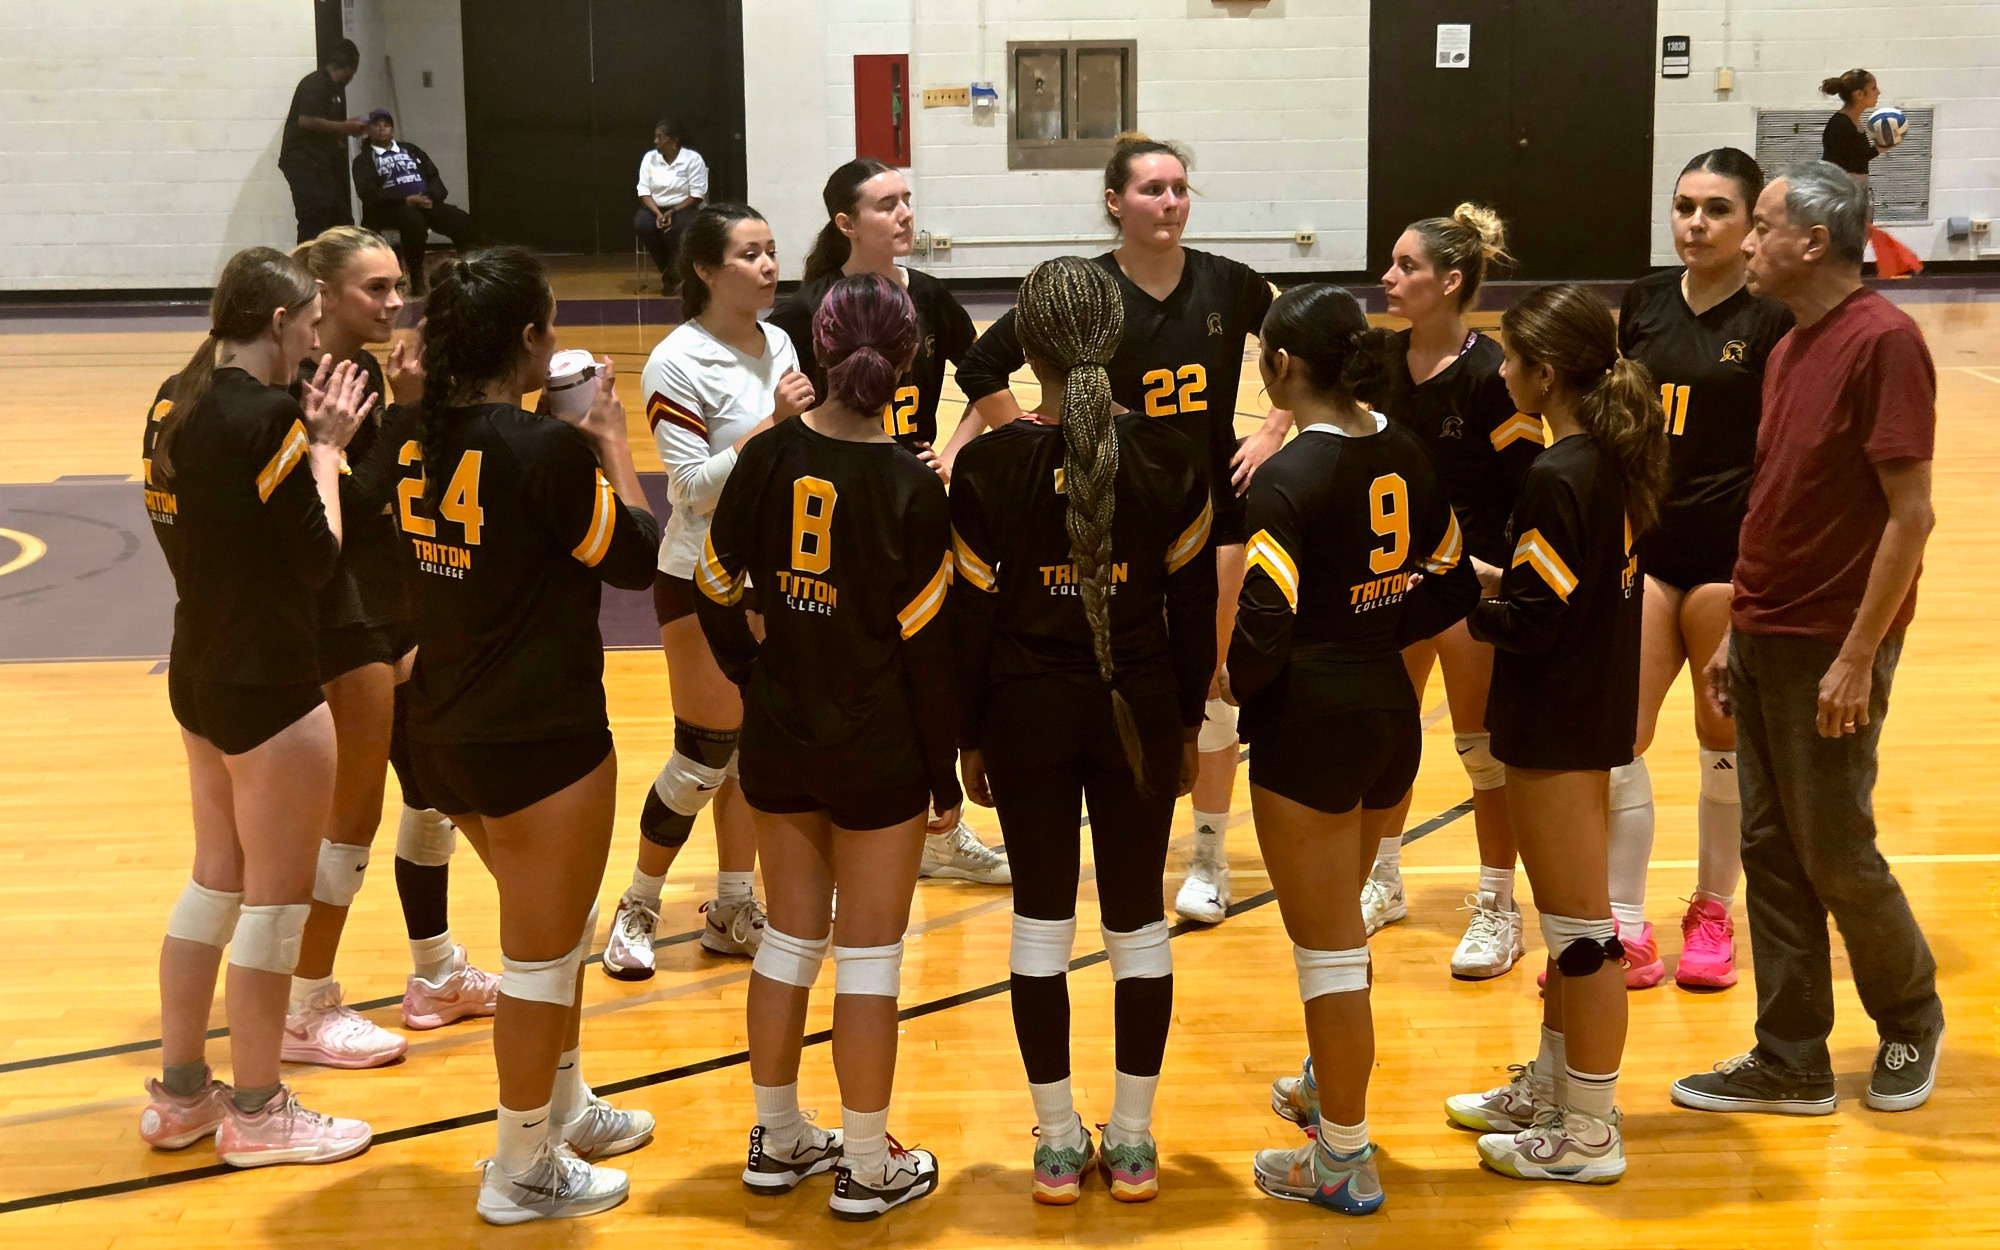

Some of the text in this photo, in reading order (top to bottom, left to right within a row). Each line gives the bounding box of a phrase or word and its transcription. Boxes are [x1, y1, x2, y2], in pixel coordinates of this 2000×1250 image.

[1142, 363, 1208, 418] 22
[1660, 382, 1691, 436] 11
[883, 385, 920, 436] 12
[397, 439, 485, 545] 24
[791, 475, 838, 575] 8
[1368, 472, 1411, 575] 9
[412, 538, 471, 570] TRITON
[420, 561, 464, 580] COLLEGE
[776, 570, 838, 608] TITON
[1039, 562, 1128, 586] TRIN
[1050, 584, 1117, 596] COLE
[786, 594, 832, 616] CLLEGE
[1354, 592, 1404, 614] COLLEGE
